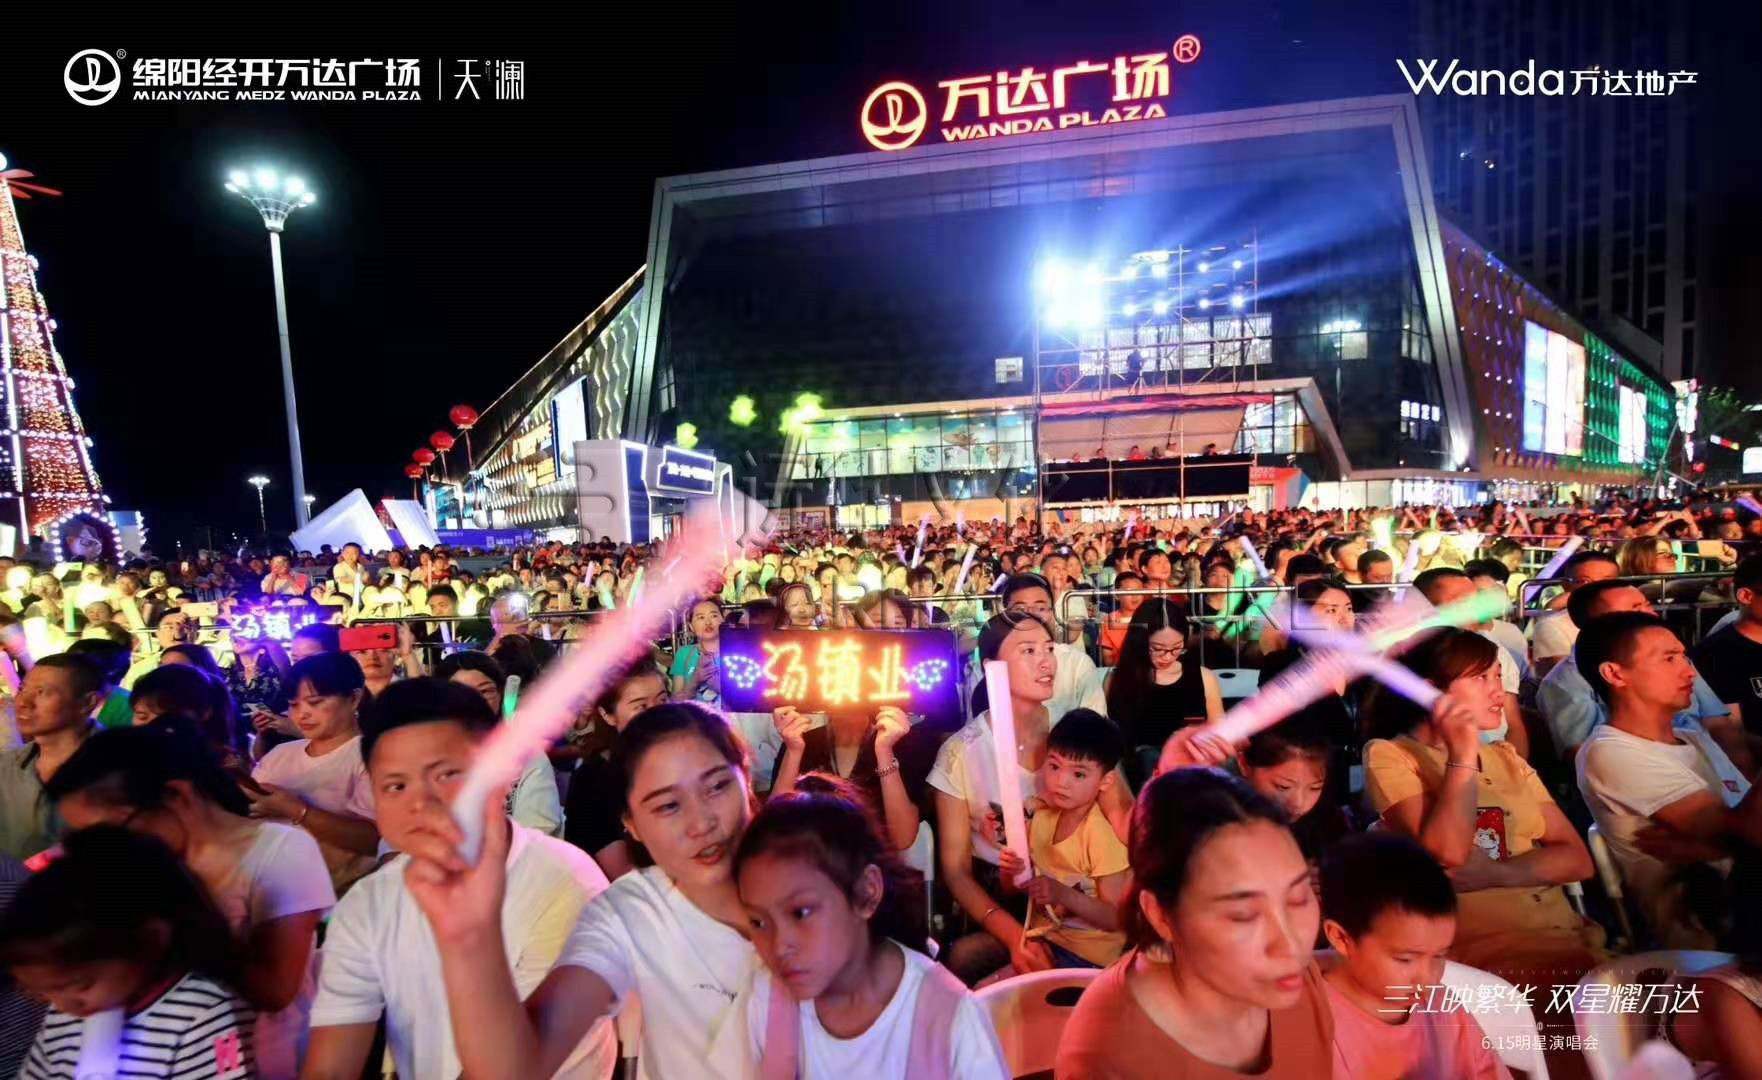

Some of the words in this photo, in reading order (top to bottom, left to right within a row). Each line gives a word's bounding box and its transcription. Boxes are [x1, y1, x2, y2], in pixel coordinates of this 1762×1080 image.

[938, 52, 1170, 122] 万达广场
[940, 119, 1053, 142] WANDA
[1058, 103, 1167, 130] PLAZA
